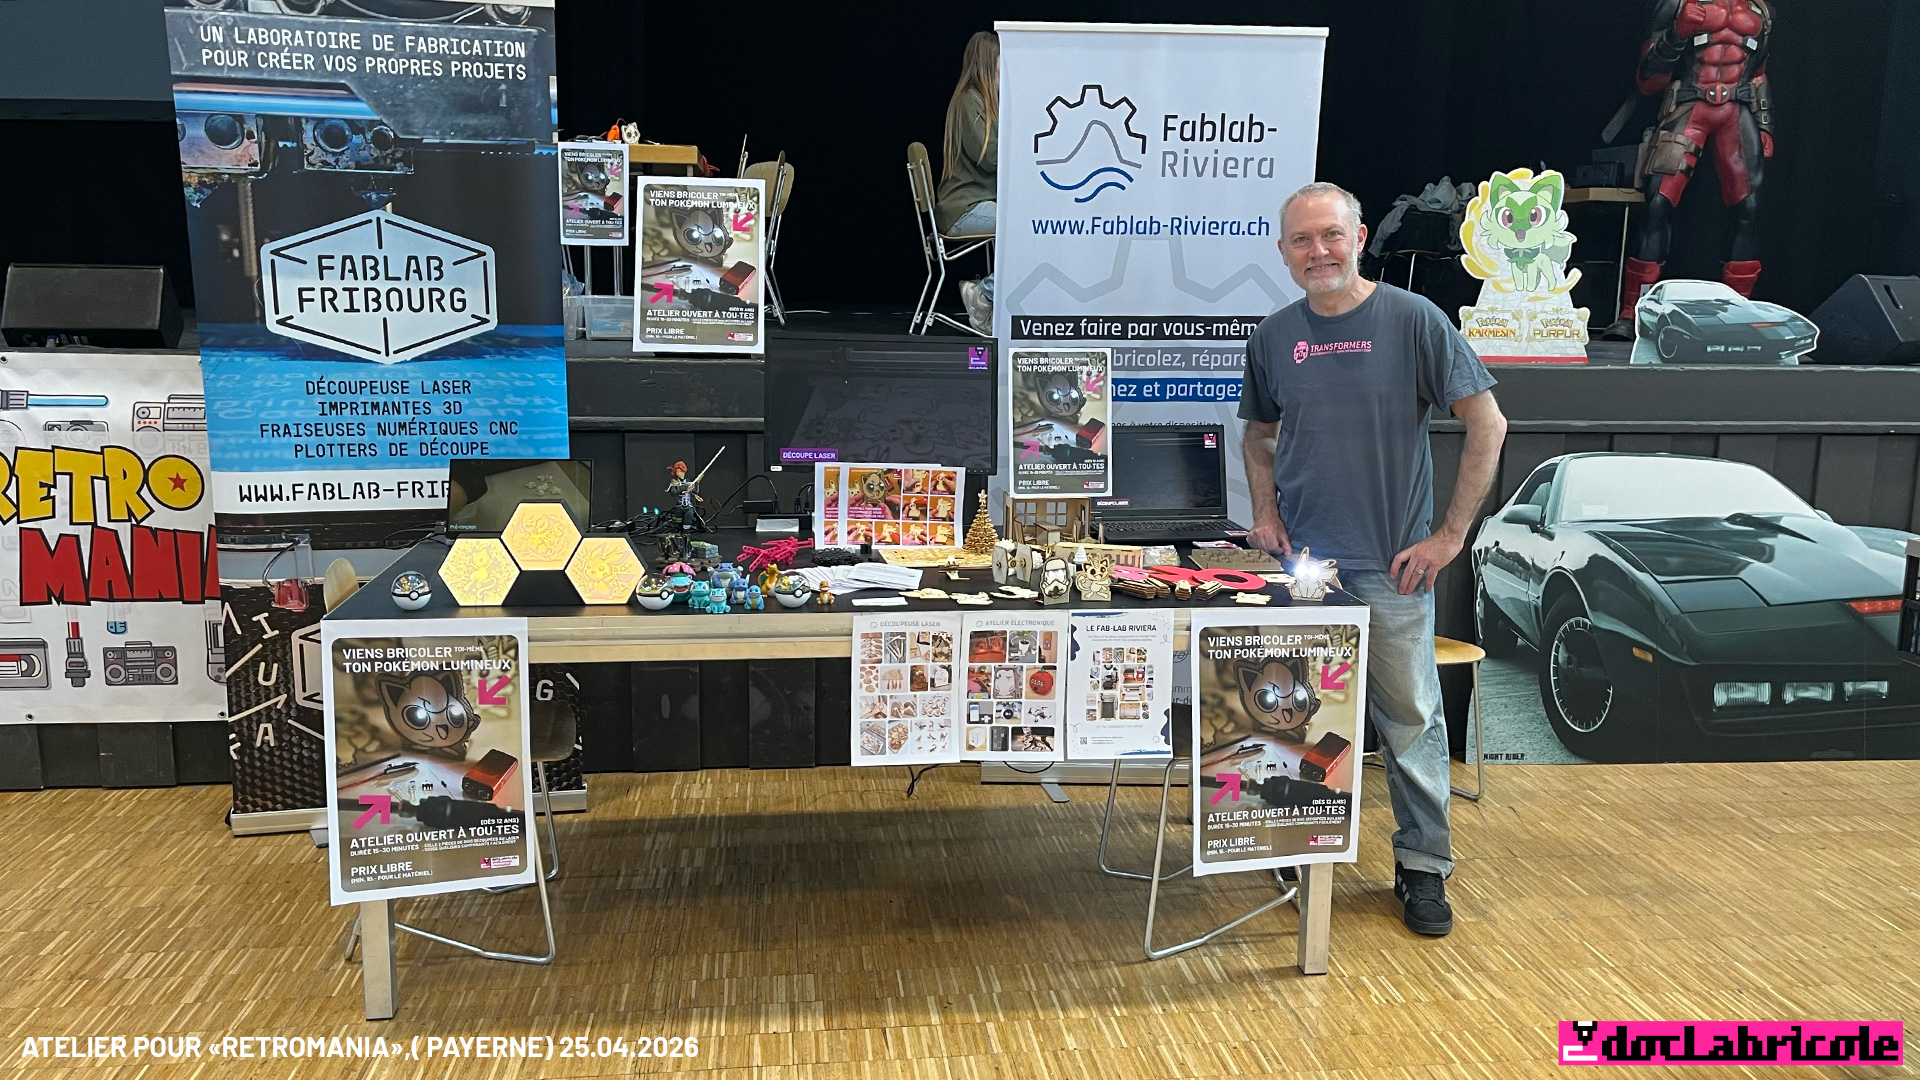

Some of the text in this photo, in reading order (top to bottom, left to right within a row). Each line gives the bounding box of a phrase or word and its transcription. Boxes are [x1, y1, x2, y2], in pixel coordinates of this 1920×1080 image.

[200, 27, 526, 58] UN LABORATOIRE DE FABRICATION
[202, 47, 526, 80] POUR CRÉER VOS PROPRES PROJETS
[1163, 113, 1277, 143] Fablab-
[1161, 149, 1275, 178] Riviera
[650, 190, 675, 198] VIENS
[677, 191, 718, 199] BRICOLER
[669, 199, 709, 208] POKÉMON
[711, 201, 754, 209] LUMINEUX
[1032, 215, 1270, 236] www.Fablab-Riviera.ch
[317, 254, 444, 282] FABLAB
[297, 287, 468, 314] FRIBOURG
[682, 310, 713, 318] OUVERT
[714, 310, 720, 318] À
[1020, 319, 1074, 336] Venez
[1080, 319, 1121, 336] faire
[1128, 322, 1158, 338] par
[1468, 328, 1516, 338] KARMESIN
[1534, 329, 1580, 338] PURPUR
[1311, 341, 1371, 353] TRANSFORMERS
[1113, 349, 1186, 369] bricolez,
[306, 376, 410, 396] DÉCOUPEUSE
[421, 380, 472, 395] LASER
[1143, 382, 1160, 397] et
[1165, 382, 1243, 400] partagez
[318, 401, 433, 416] IMPRIMANTES
[442, 400, 463, 416] 3D
[260, 417, 519, 439] FRAISEUSES NUMÉRIQUES CNC
[294, 442, 378, 459] PLOTTERS
[389, 441, 409, 457] DE
[419, 437, 490, 457] DÉCOUPE
[783, 451, 813, 459] DÉCOUPE
[1072, 462, 1077, 470] À
[1011, 619, 1055, 627] ÉLECTRONIQUE
[1208, 636, 1242, 647] VIENS
[1245, 635, 1302, 646] BRICOLER
[342, 648, 384, 659] VIENS
[386, 647, 452, 658] BRICOLER
[1208, 646, 1352, 659] TON POKÉMON LUMINEUX
[343, 659, 512, 673] TON POKÉMON LUMINEUX
[536, 679, 554, 701] G
[481, 818, 495, 826] (DÈS
[504, 817, 519, 825] ANS)
[1208, 811, 1249, 823] ATELIER
[1251, 807, 1291, 819] OUVERT
[1292, 805, 1300, 817] À
[350, 834, 403, 849] ATELIER
[406, 829, 455, 843] OUVERT
[457, 826, 466, 839] À
[1208, 837, 1256, 849] PRIX LIBRE
[350, 849, 372, 857] DURÉE
[391, 844, 419, 853] MINUTES
[351, 861, 413, 877] PRIX LIBRE
